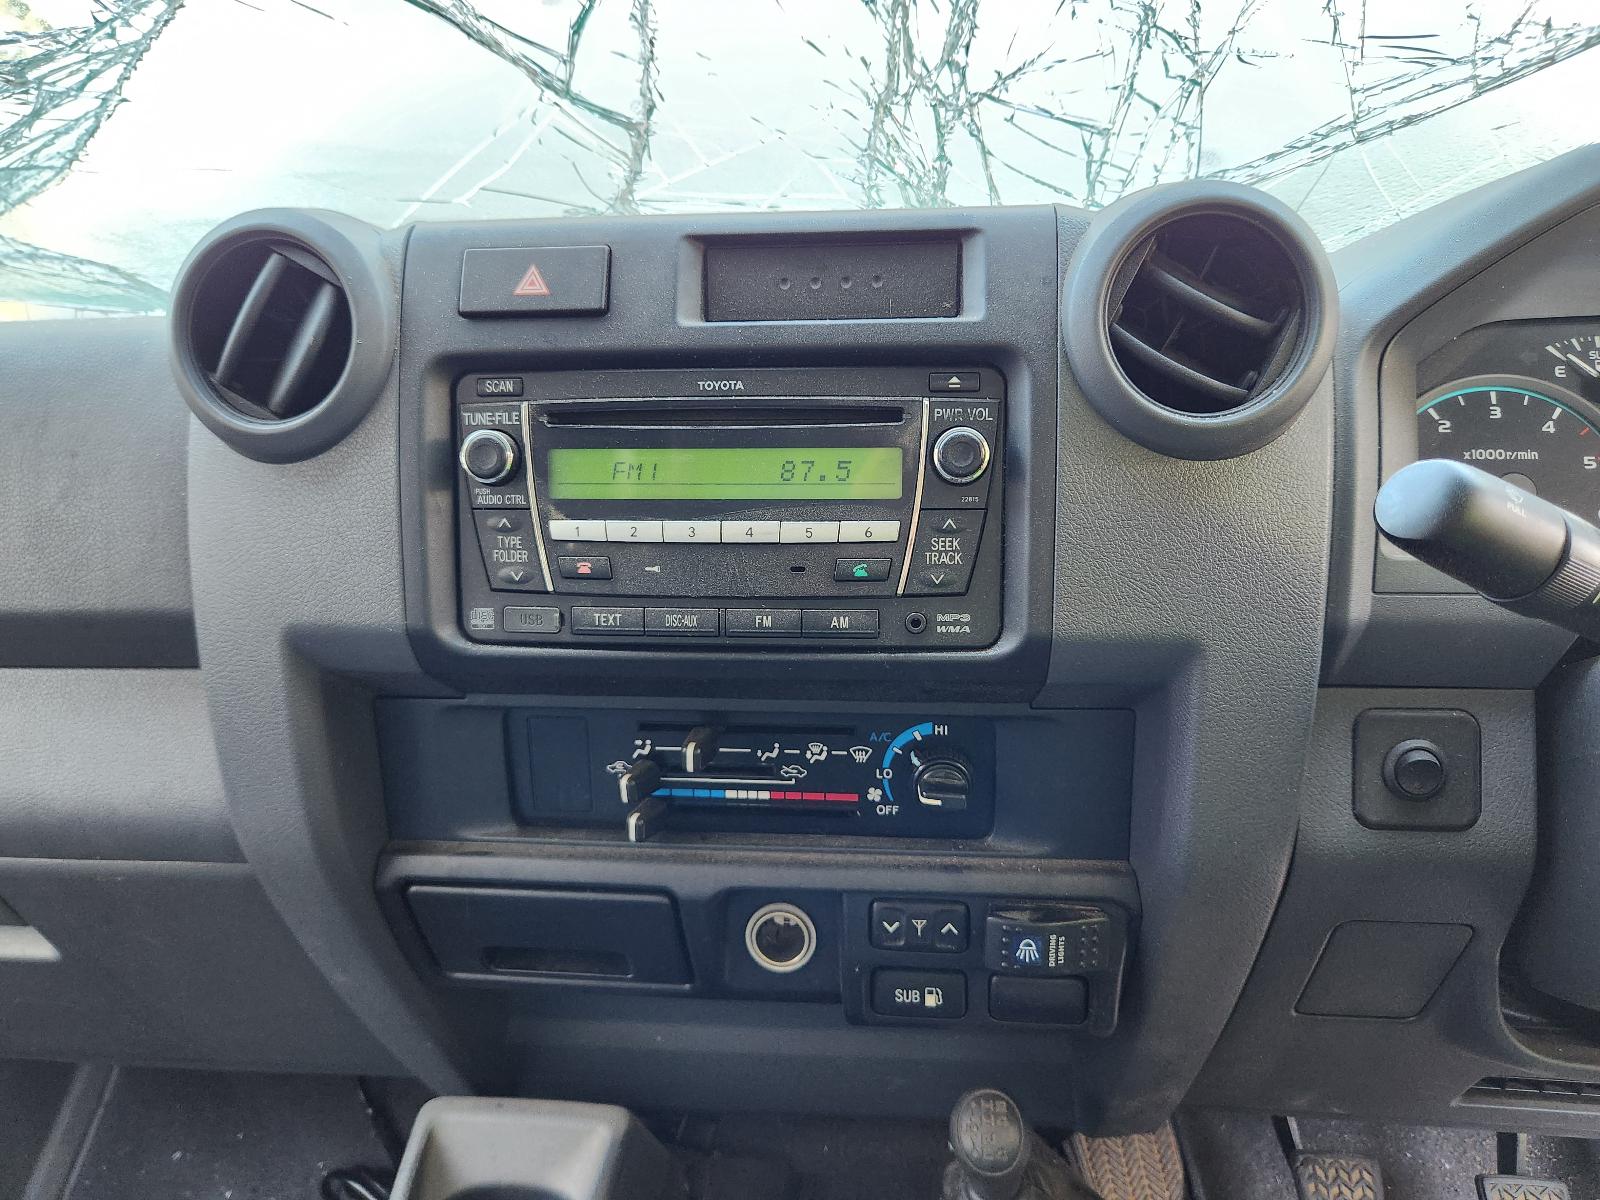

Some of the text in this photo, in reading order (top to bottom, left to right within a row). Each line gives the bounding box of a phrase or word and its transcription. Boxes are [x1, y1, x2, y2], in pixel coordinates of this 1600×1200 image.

[1554, 365, 1567, 378] E
[485, 379, 514, 393] SCAN
[697, 380, 744, 391] TOYOTA
[934, 407, 993, 421] PWR VOL
[1489, 406, 1502, 419] 3
[1438, 420, 1451, 433] 2
[1541, 420, 1556, 434] 4
[1583, 456, 1597, 469] 5
[780, 460, 852, 482] 87.5
[477, 494, 527, 505] AUDIO CTRL
[575, 526, 581, 537] 1
[630, 526, 637, 538] 2
[688, 526, 696, 538] 3
[745, 526, 754, 538] 4
[805, 527, 813, 539] 5
[864, 527, 873, 538] 6
[497, 536, 523, 549] TYPE
[931, 538, 960, 551] SEEK
[493, 550, 529, 563] FOLDER
[925, 552, 963, 565] TRACK
[520, 613, 543, 626] USB
[593, 613, 623, 627] TEXT
[755, 616, 772, 629] FM
[830, 616, 849, 629] AM
[936, 613, 971, 622] MP3
[936, 625, 971, 633] WMA
[934, 724, 948, 735] HI
[869, 731, 892, 742] A/C
[876, 768, 893, 779] LO
[876, 805, 899, 815] OFF
[1048, 934, 1057, 968] DRIVING
[1057, 936, 1065, 964] LIGHTS
[894, 988, 921, 1003] SUB
